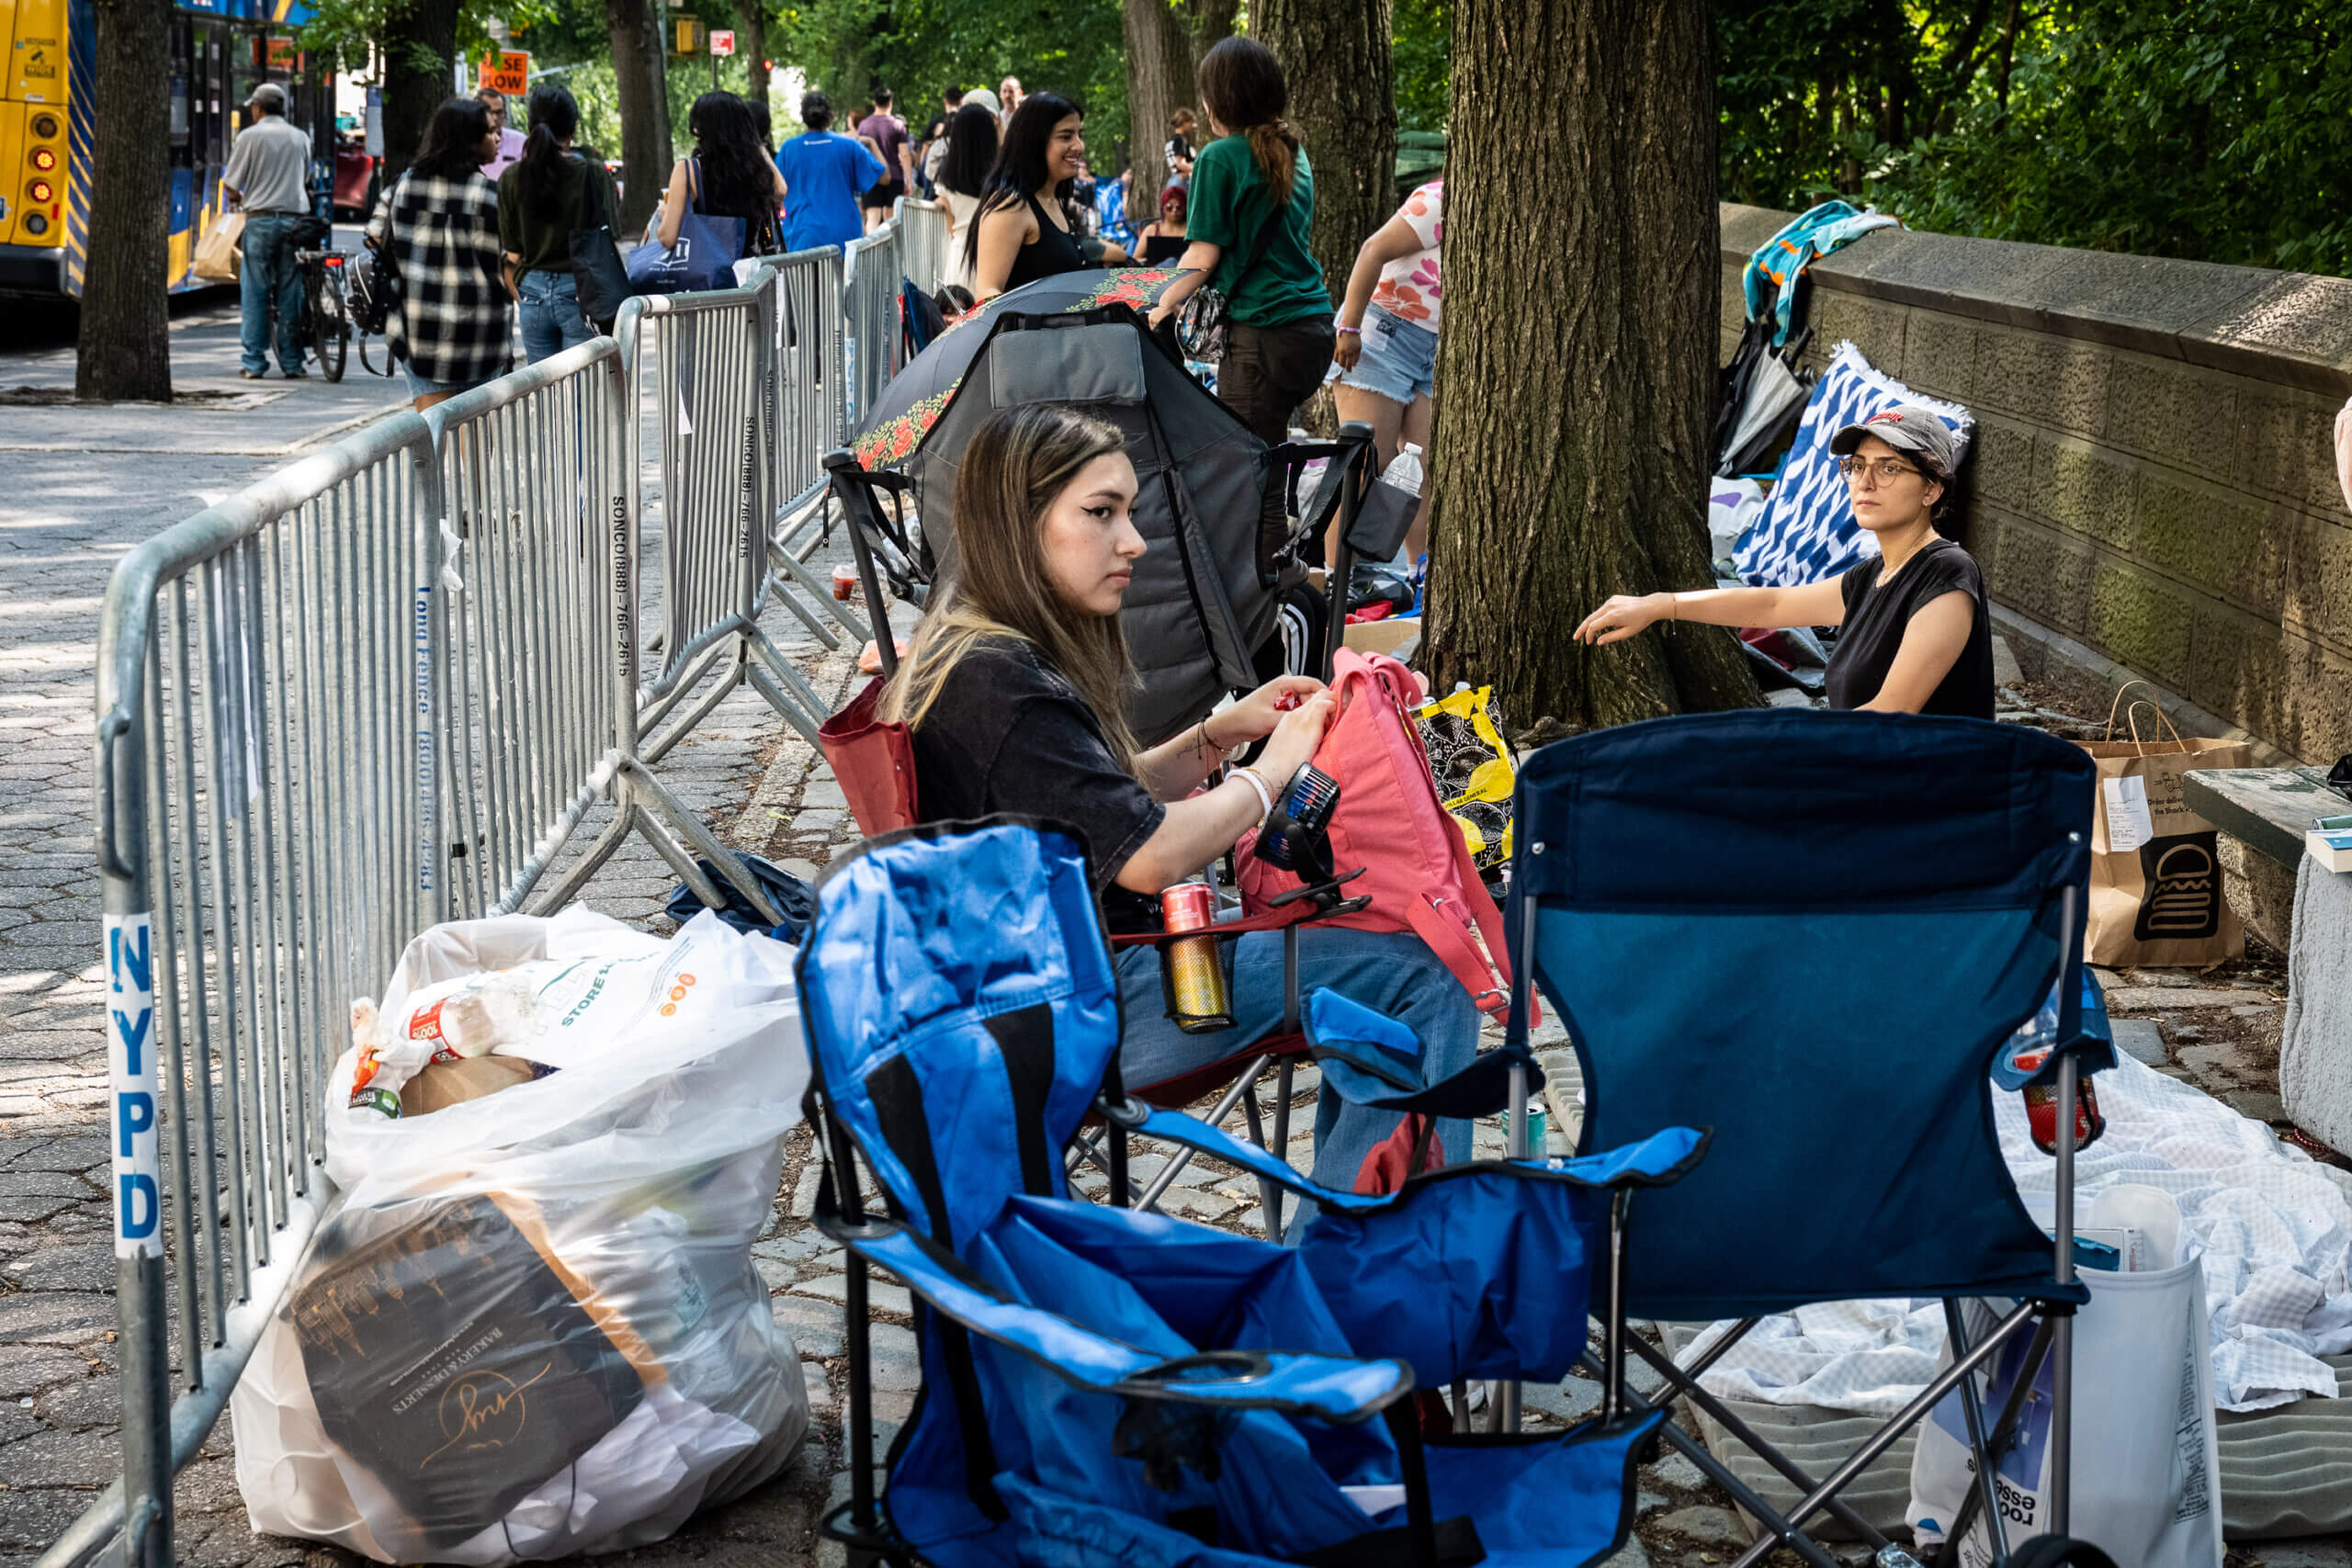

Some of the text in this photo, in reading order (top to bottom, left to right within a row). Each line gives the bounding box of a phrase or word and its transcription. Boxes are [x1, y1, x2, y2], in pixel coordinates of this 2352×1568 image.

[740, 416, 755, 558] SONCO(888)-766-2615
[613, 496, 629, 677] SONCO(888)-766-2615
[416, 648, 432, 714] Fence
[1464, 787, 1487, 802] GENERAL
[561, 976, 605, 1027] STORE
[413, 1024, 439, 1040] 100%
[110, 926, 158, 1237] NYPD
[458, 1325, 503, 1368] BAKERY
[391, 1367, 449, 1415] DESSERTS
